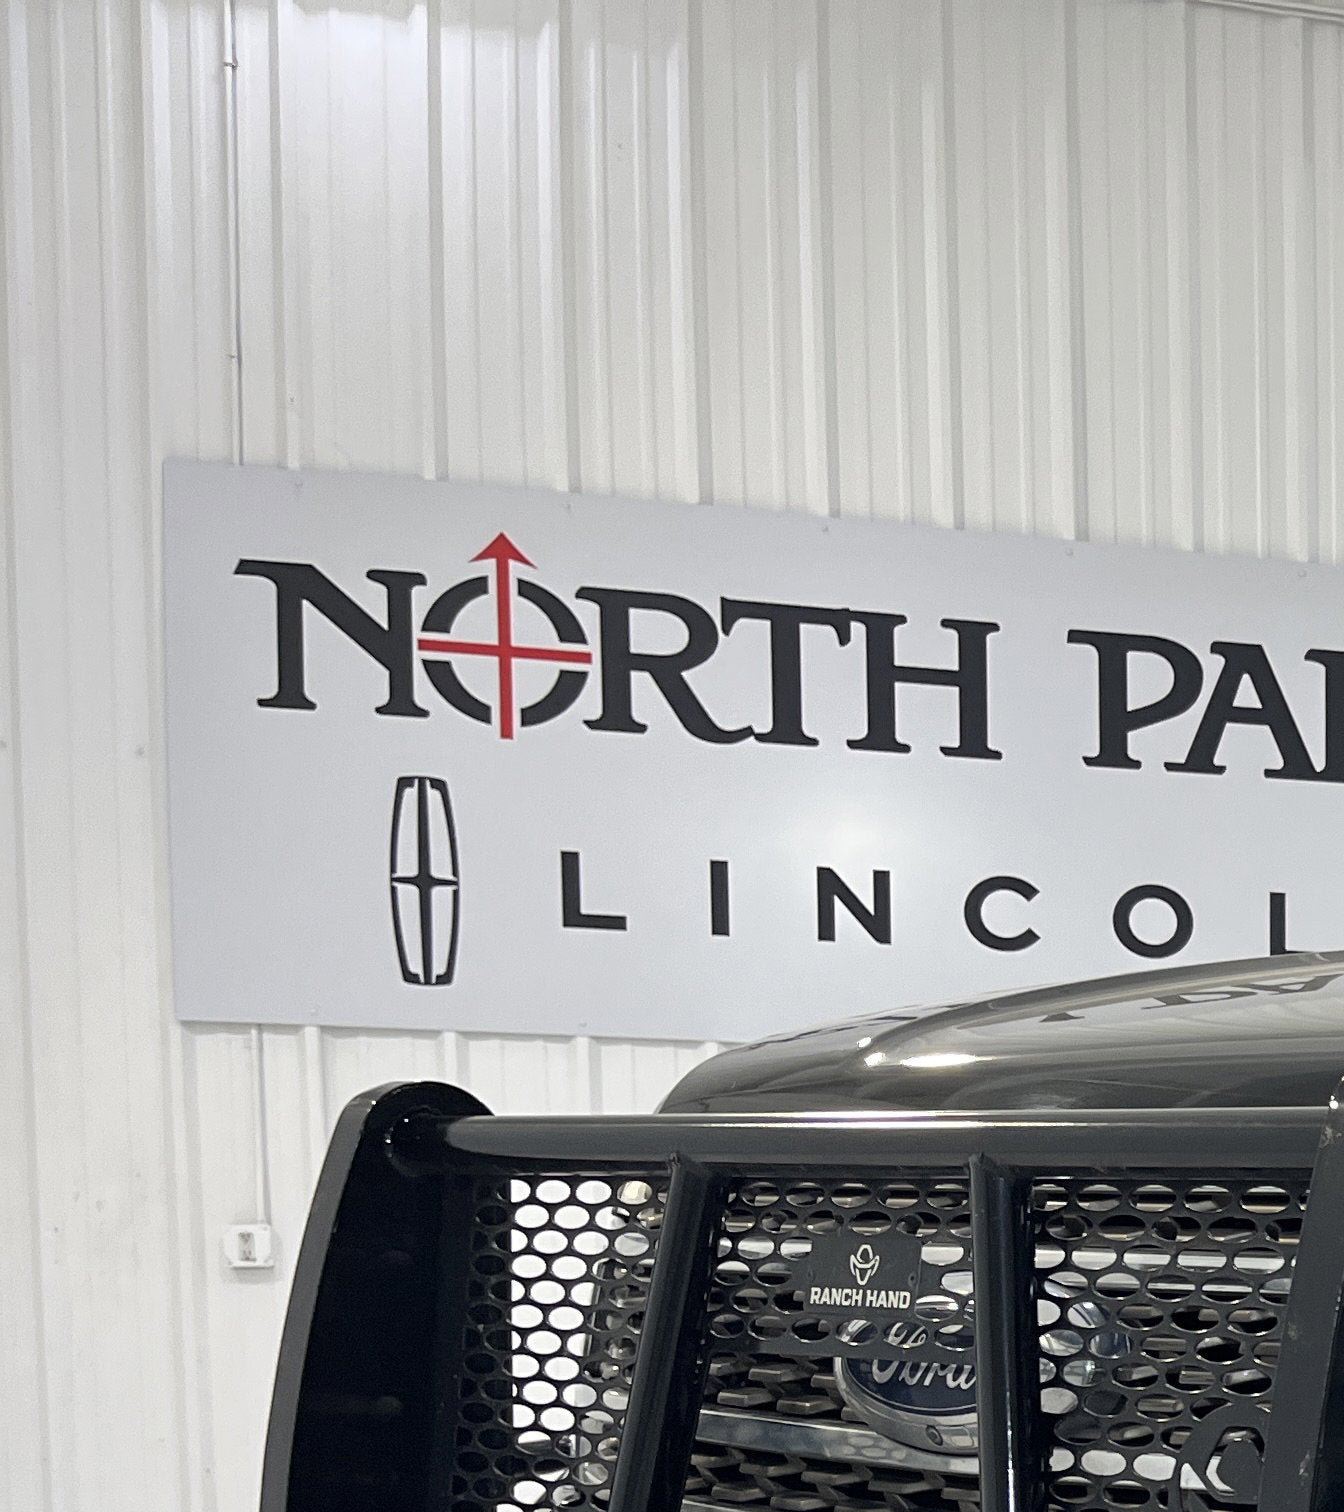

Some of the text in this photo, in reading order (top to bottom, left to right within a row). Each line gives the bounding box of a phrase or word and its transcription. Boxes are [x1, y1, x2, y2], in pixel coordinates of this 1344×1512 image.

[236, 556, 1002, 760] NORTH
[809, 1286, 911, 1311] RANCH HAND
